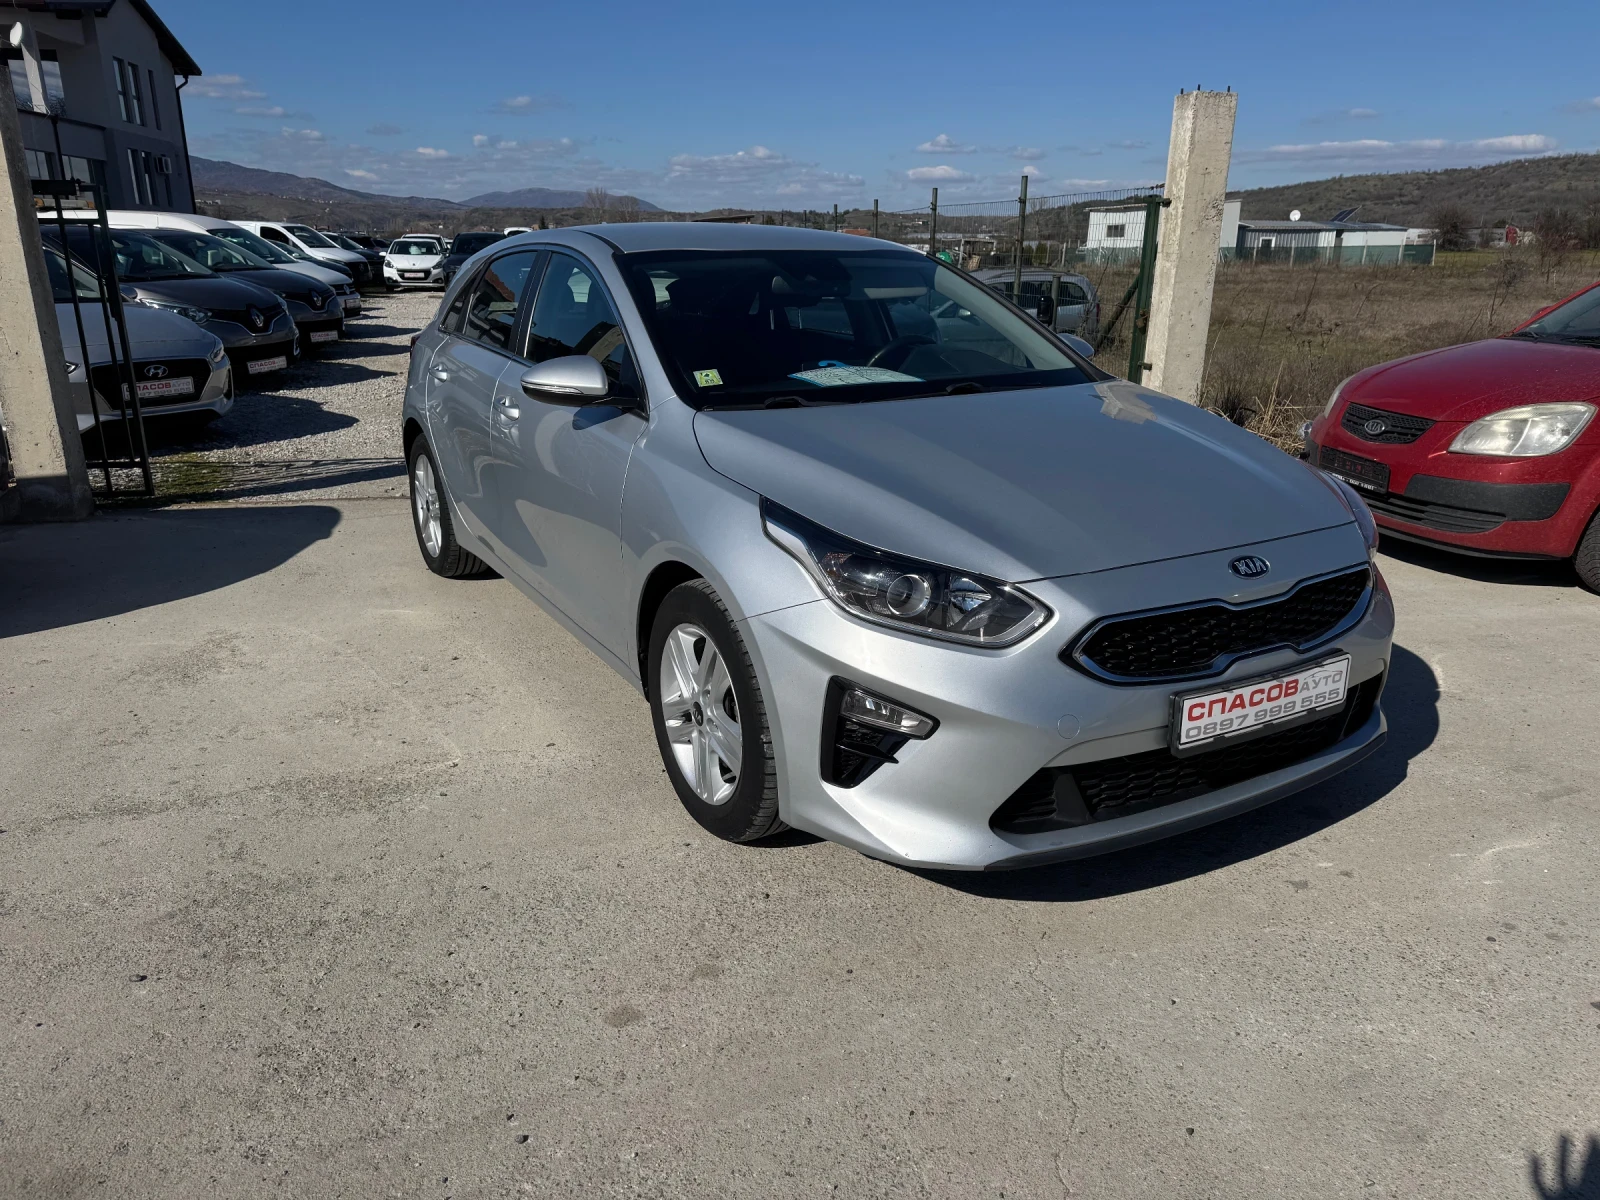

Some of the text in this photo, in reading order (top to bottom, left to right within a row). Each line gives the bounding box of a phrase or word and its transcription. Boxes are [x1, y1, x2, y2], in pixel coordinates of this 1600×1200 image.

[1234, 557, 1267, 575] KIA
[1185, 687, 1341, 740] 0897 999 555
[1187, 671, 1343, 722] СПАСОВ АУТО
